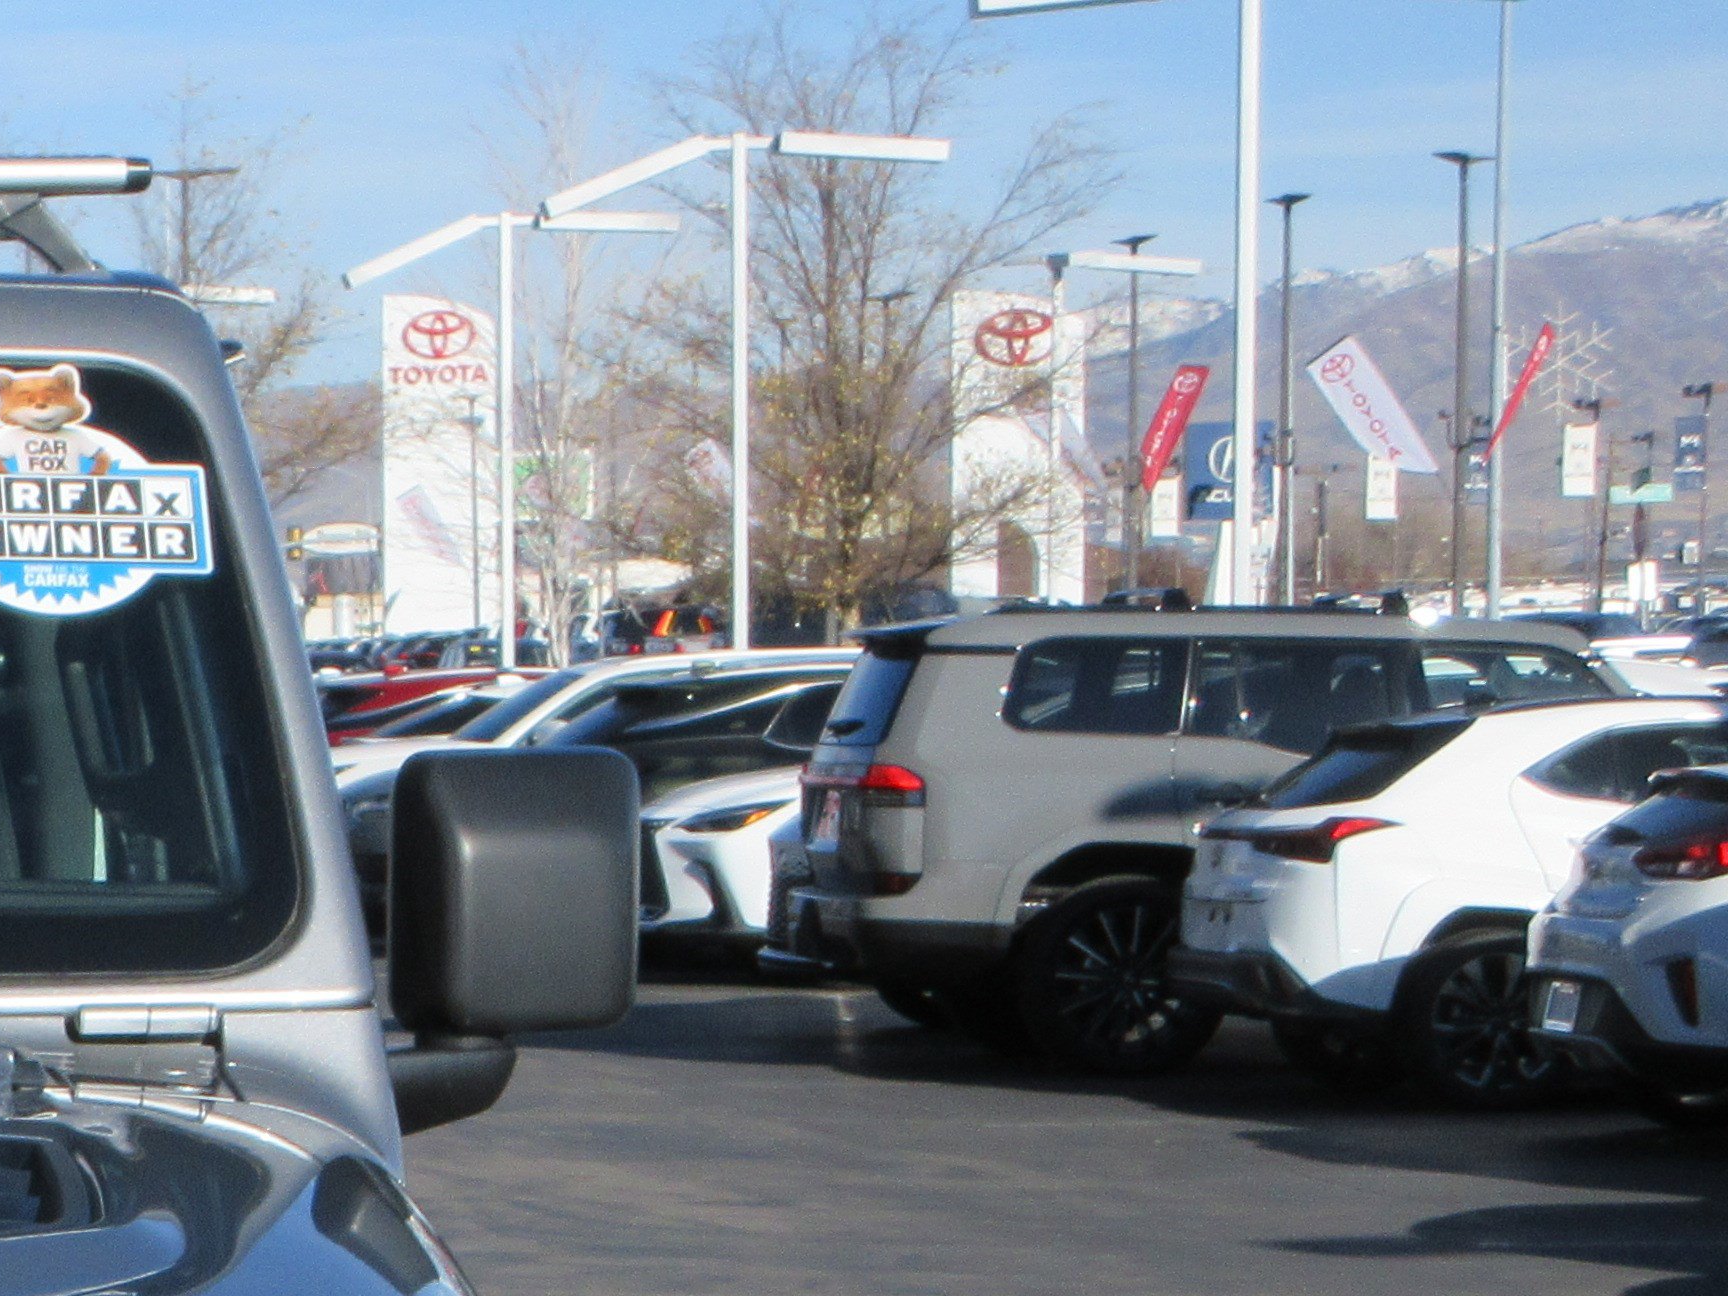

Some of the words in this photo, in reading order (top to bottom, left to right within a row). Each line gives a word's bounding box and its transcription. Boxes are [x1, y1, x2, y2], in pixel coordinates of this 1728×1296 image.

[389, 364, 487, 385] TOYOTA
[1343, 381, 1402, 459] TOYOTA
[24, 439, 67, 455] CAR
[28, 455, 69, 471] FOX
[23, 573, 90, 588] CARFAX
